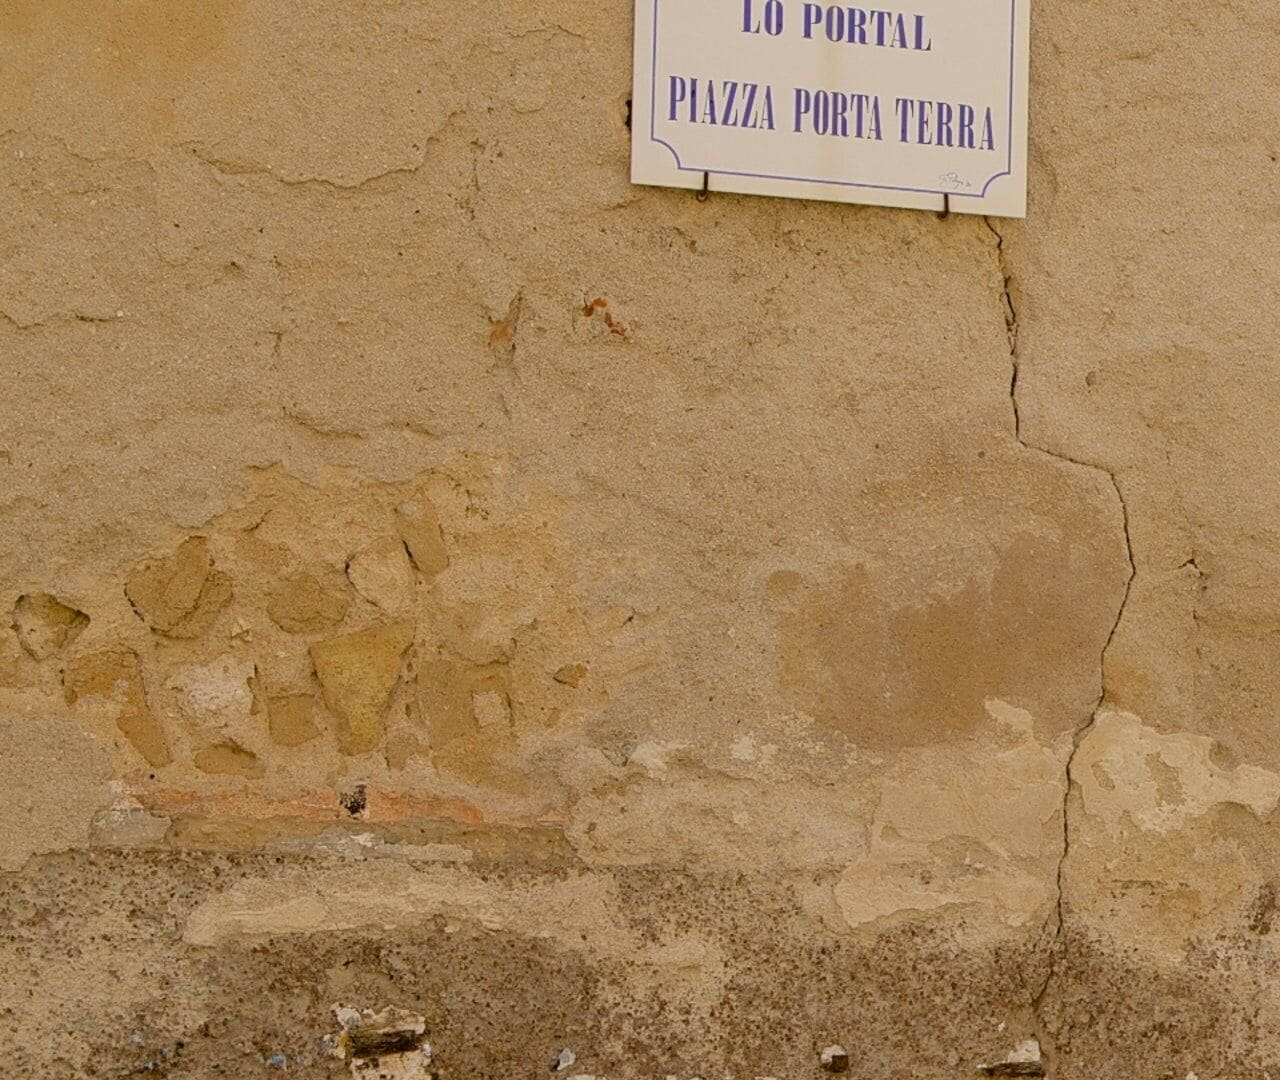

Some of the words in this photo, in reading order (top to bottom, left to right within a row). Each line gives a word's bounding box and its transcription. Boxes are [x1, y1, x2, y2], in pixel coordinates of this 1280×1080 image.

[741, 0, 784, 36] LO
[802, 3, 932, 51] PORTAL
[667, 75, 776, 131] PIAZZA
[793, 87, 883, 141] PORTA
[895, 97, 995, 151] TERRA
